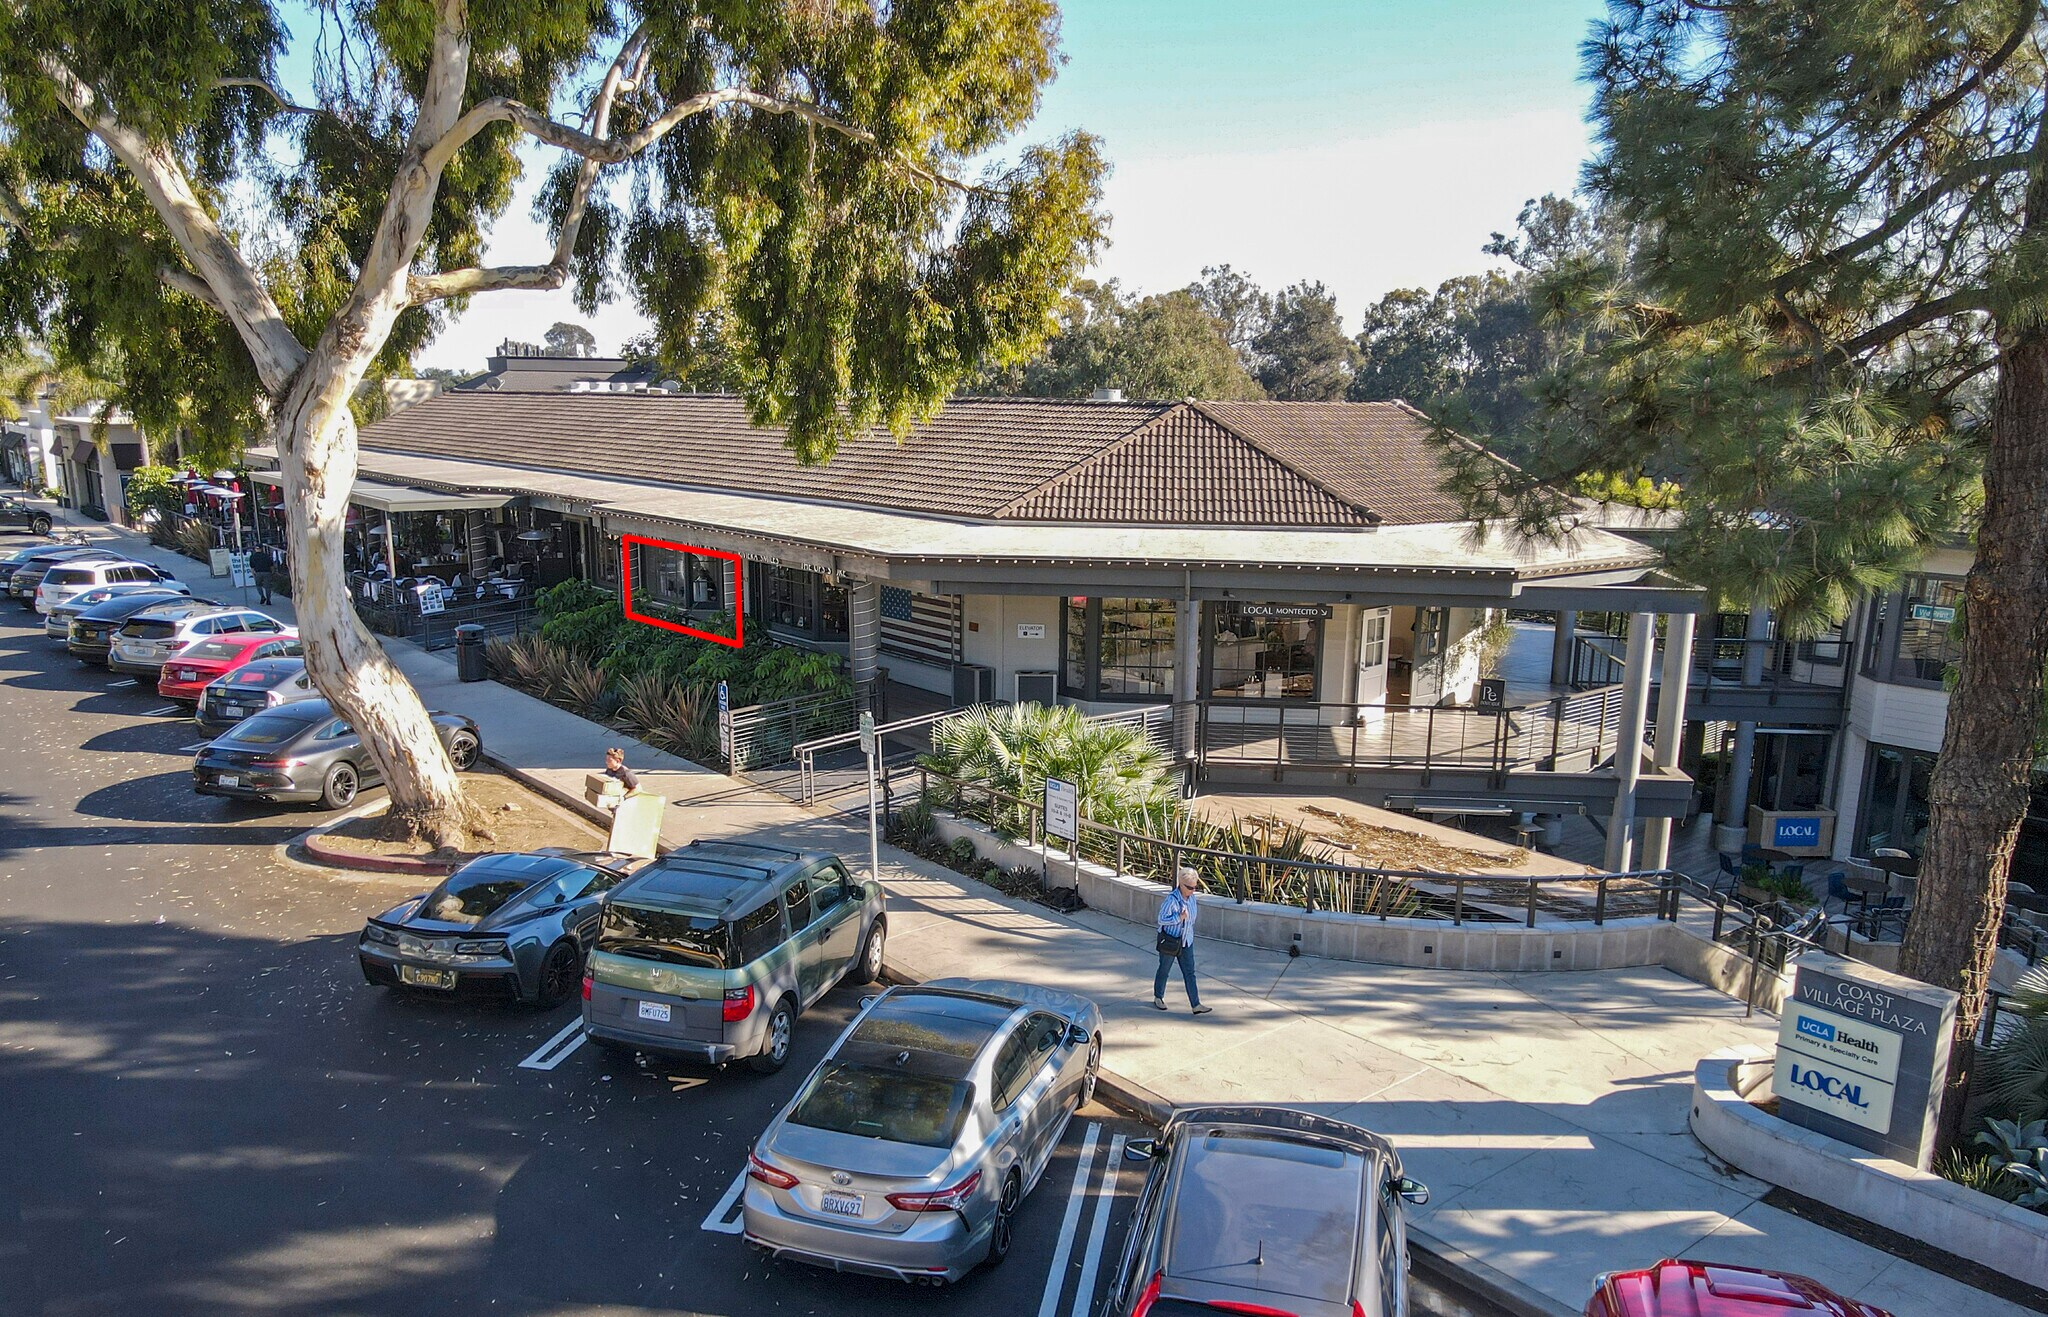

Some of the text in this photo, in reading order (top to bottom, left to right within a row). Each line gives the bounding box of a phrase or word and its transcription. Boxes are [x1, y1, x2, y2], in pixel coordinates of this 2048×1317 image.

[801, 562, 813, 571] THE
[814, 564, 826, 574] UPS
[1243, 606, 1318, 615] LOCAL MONTECITO
[1919, 608, 1931, 617] We
[1780, 825, 1816, 836] LOCAL
[1837, 982, 1895, 1009] COAST
[1803, 985, 1927, 1036] VILLAGE PLAZA
[1801, 1020, 1879, 1054] UCLA Health
[1795, 1033, 1821, 1048] Primary
[1829, 1044, 1860, 1061] Specialty
[1861, 1055, 1878, 1066] Care
[1790, 1063, 1870, 1109] LOCAL
[823, 1197, 861, 1215] 8RXV697
